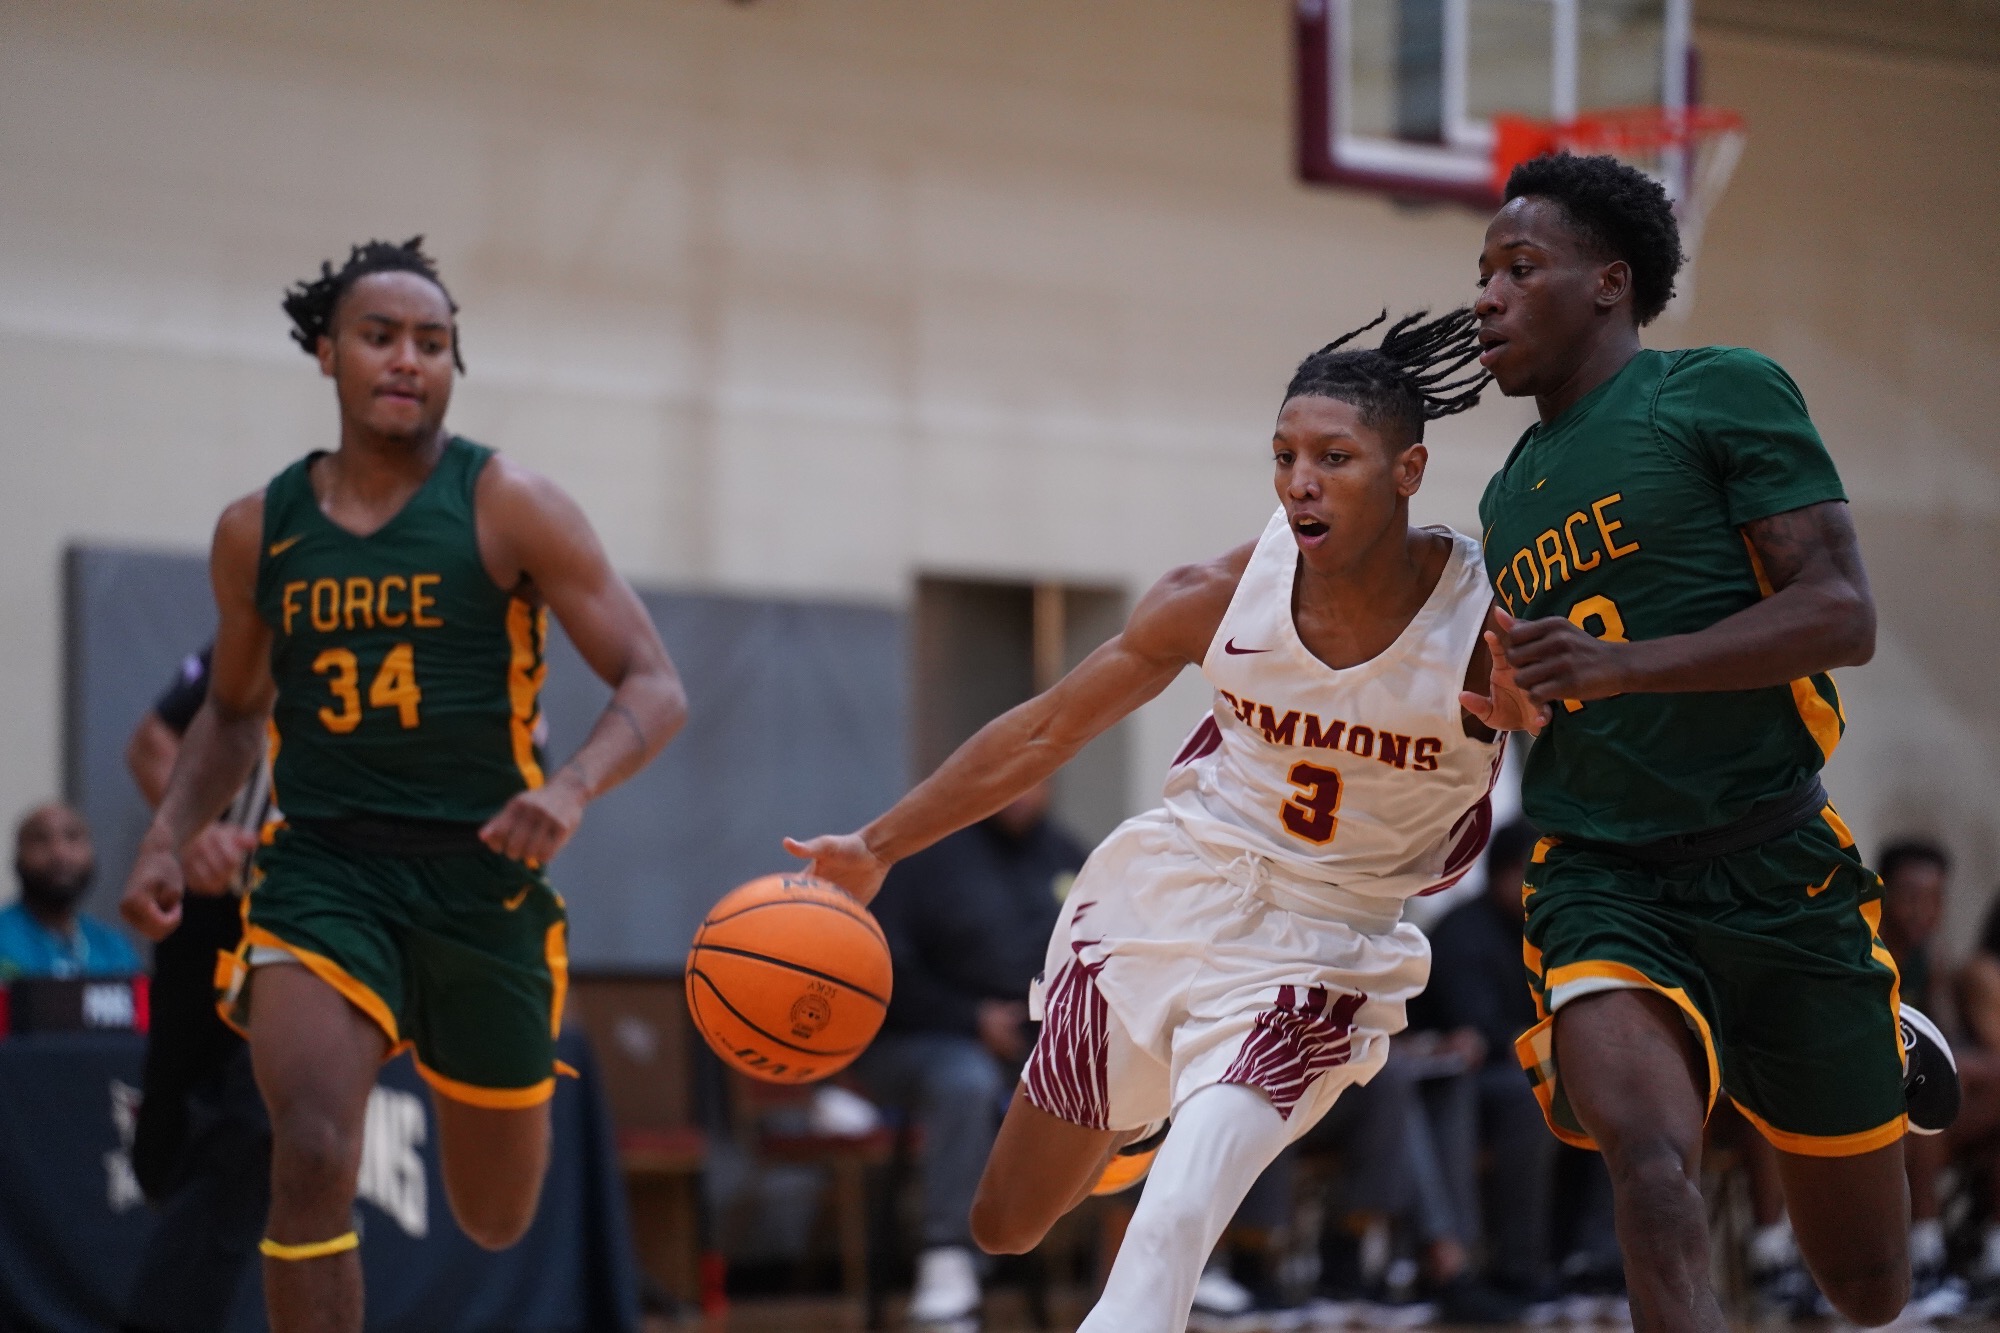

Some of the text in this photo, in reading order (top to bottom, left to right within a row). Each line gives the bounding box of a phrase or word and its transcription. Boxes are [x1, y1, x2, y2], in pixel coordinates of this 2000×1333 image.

[1495, 493, 1640, 618] FORCE
[282, 573, 444, 636] FORCE
[312, 643, 422, 734] 34
[1278, 759, 1345, 847] 3
